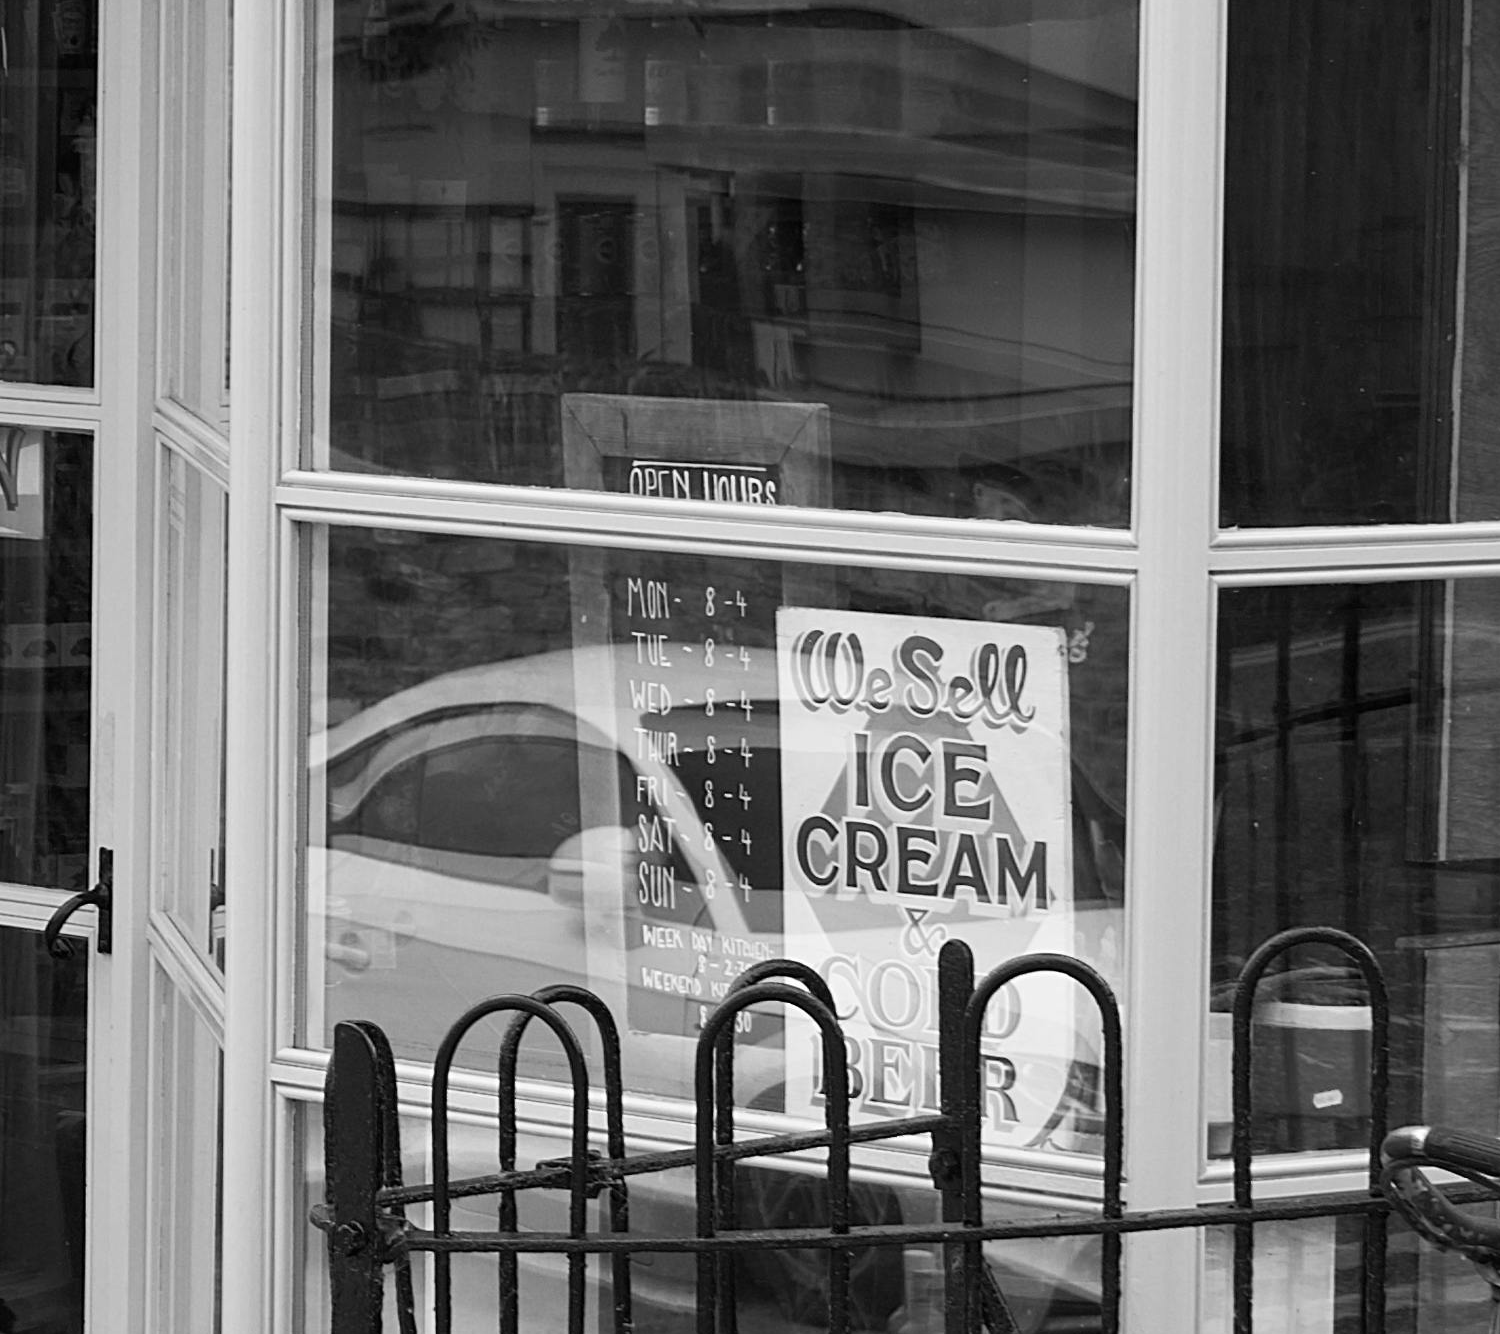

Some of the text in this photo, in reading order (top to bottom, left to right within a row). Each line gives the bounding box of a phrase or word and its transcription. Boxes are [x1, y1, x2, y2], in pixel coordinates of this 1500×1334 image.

[796, 628, 1037, 727] We Sell
[853, 731, 992, 821] ICE
[796, 815, 1049, 911] CREAM
[903, 907, 947, 957] &
[819, 955, 1022, 1040] COD
